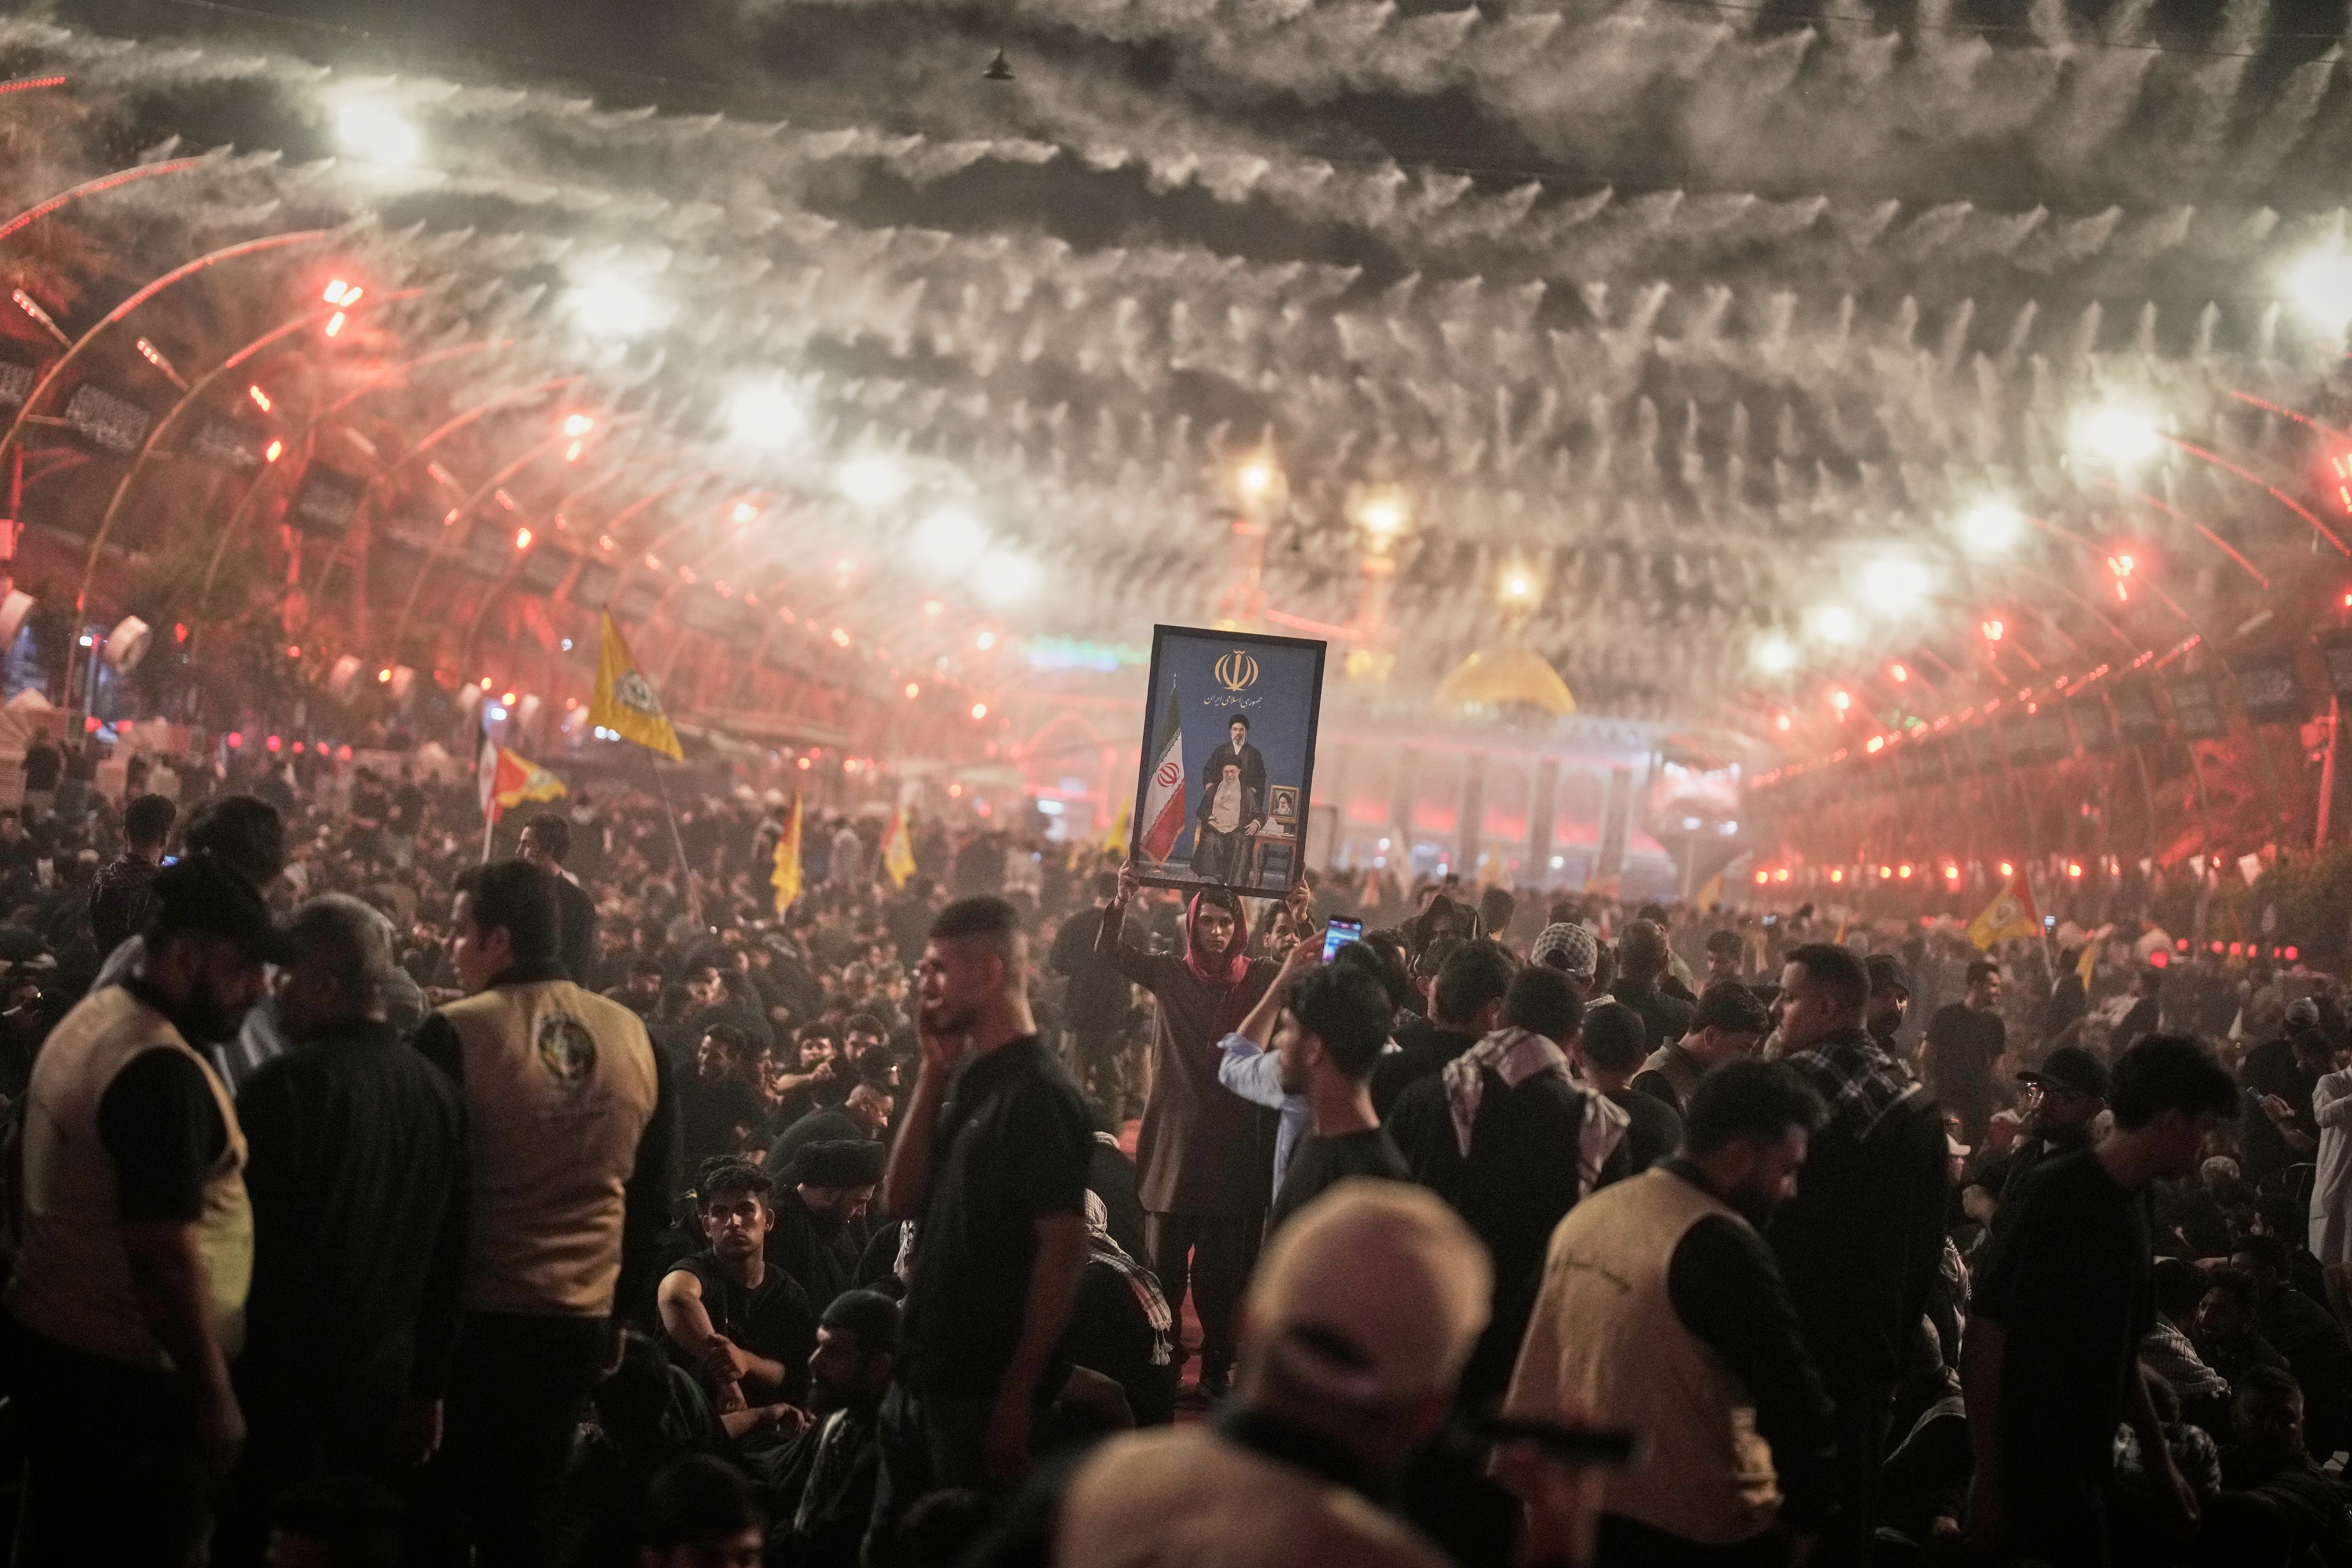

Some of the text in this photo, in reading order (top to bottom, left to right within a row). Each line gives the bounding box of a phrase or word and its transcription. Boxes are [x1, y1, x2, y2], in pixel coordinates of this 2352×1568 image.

[1204, 695, 1263, 708] جمهوری اسلامی ایران
